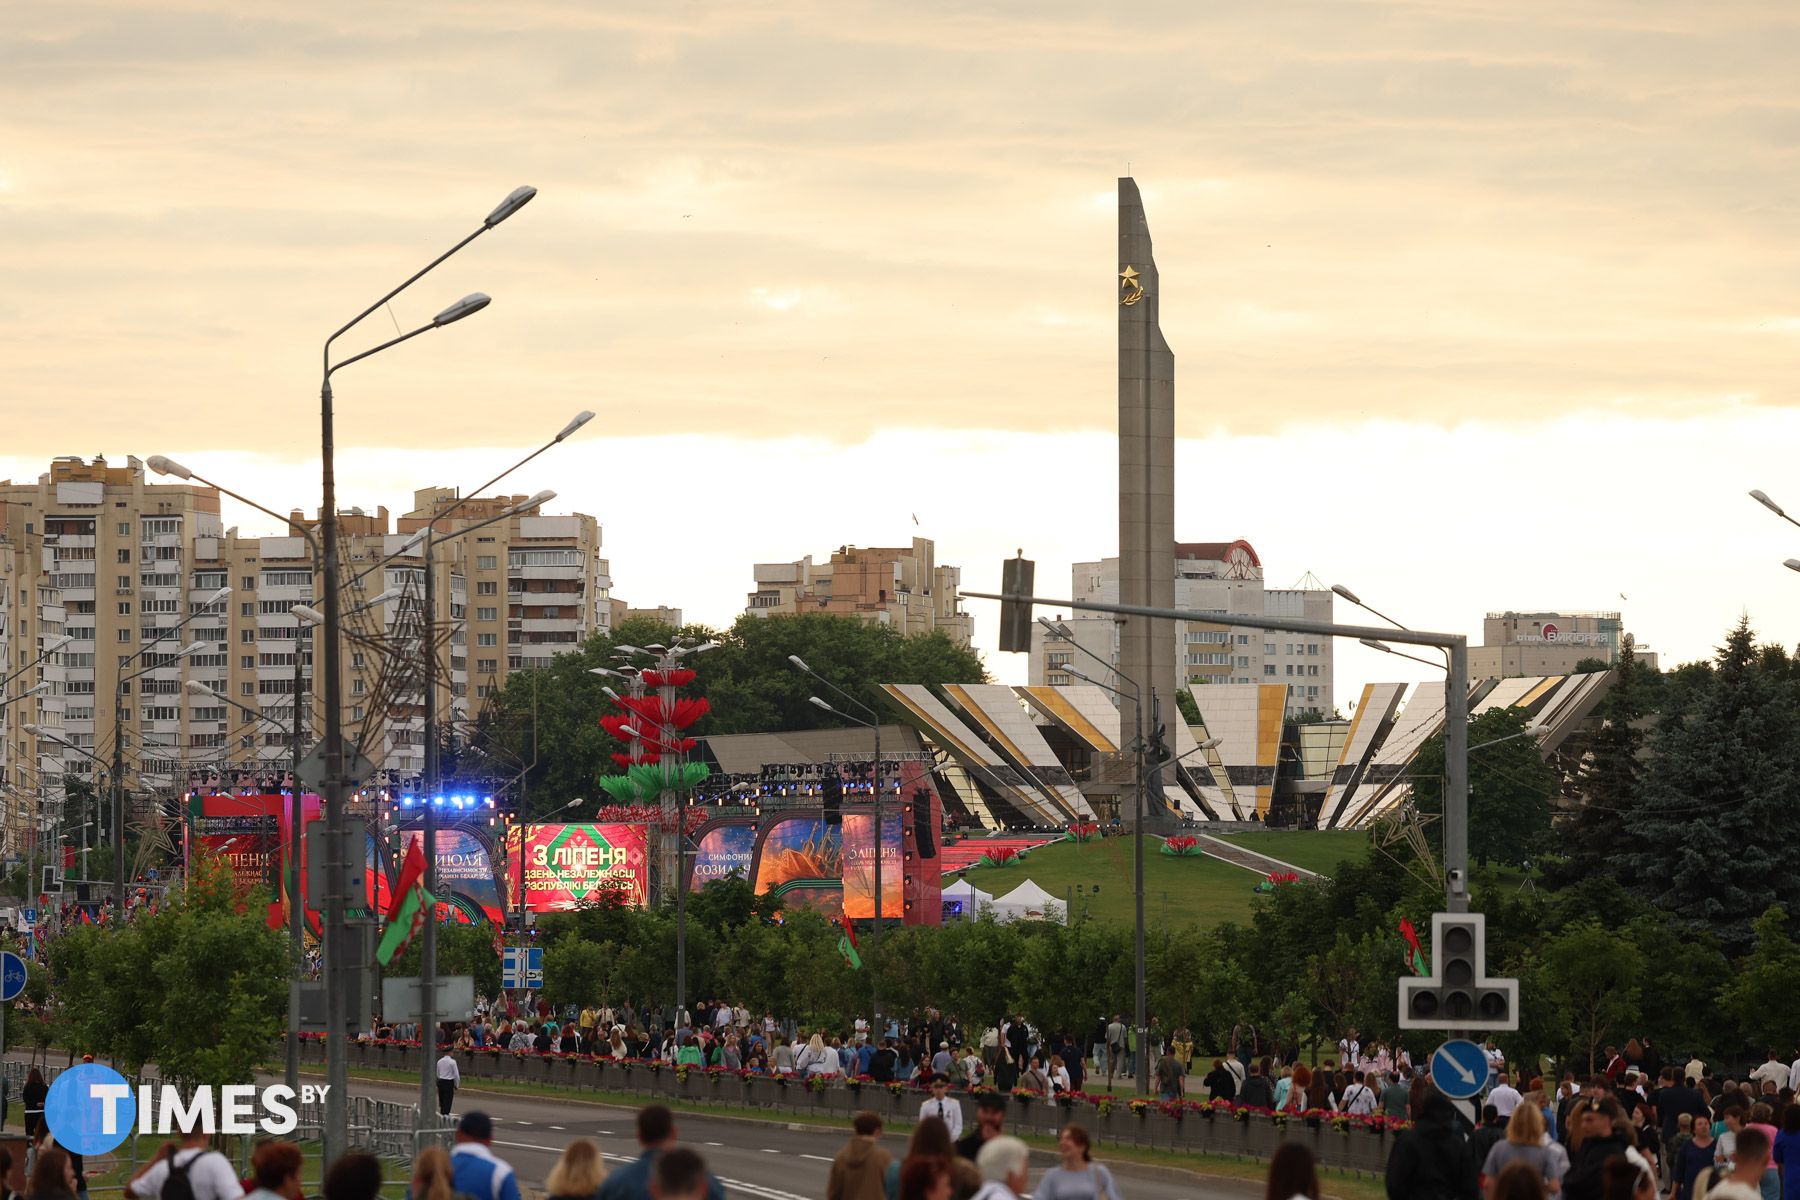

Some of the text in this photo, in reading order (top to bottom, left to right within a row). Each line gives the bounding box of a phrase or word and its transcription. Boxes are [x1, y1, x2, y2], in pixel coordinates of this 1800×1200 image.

[1547, 632, 1608, 642] ВИКТОРИЯ
[532, 845, 627, 866] 3 ЛІПЕНЯ
[708, 853, 753, 861] СИМФОНИЯ
[858, 847, 896, 858] ЛІПНЯ
[213, 852, 271, 867] ЛПЕНЯ
[434, 854, 482, 867] ИЮЛЯ
[556, 869, 636, 880] НЕЗАЛЕЖНАСЦІ
